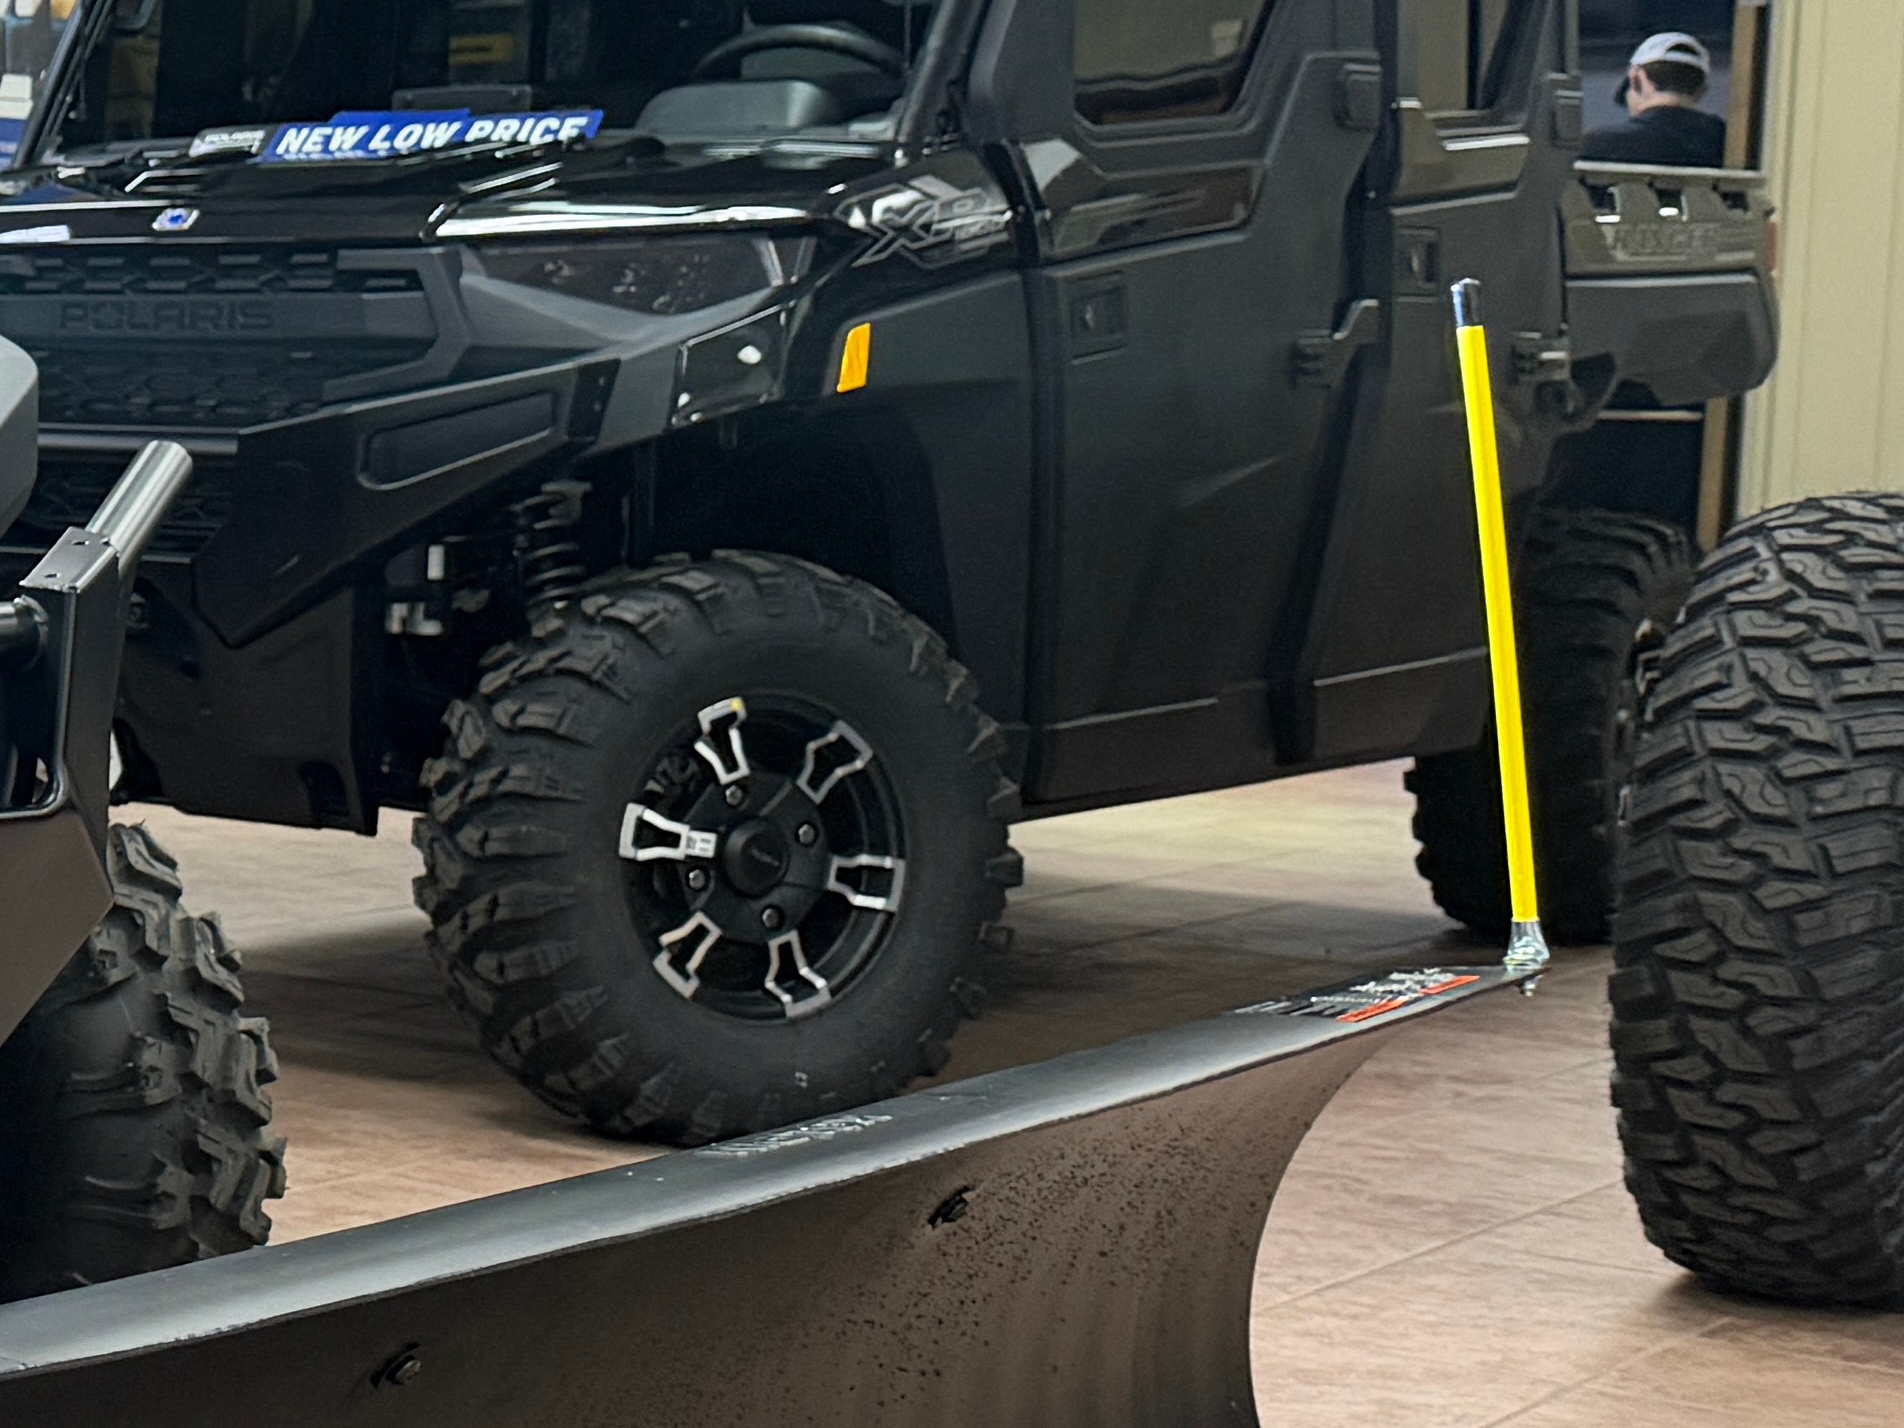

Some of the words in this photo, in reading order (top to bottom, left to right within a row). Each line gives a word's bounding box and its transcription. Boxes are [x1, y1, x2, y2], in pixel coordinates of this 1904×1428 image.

[275, 124, 370, 156] NEW
[368, 121, 463, 152] LOW
[465, 115, 590, 145] PRICE
[60, 300, 275, 332] POLARIS
